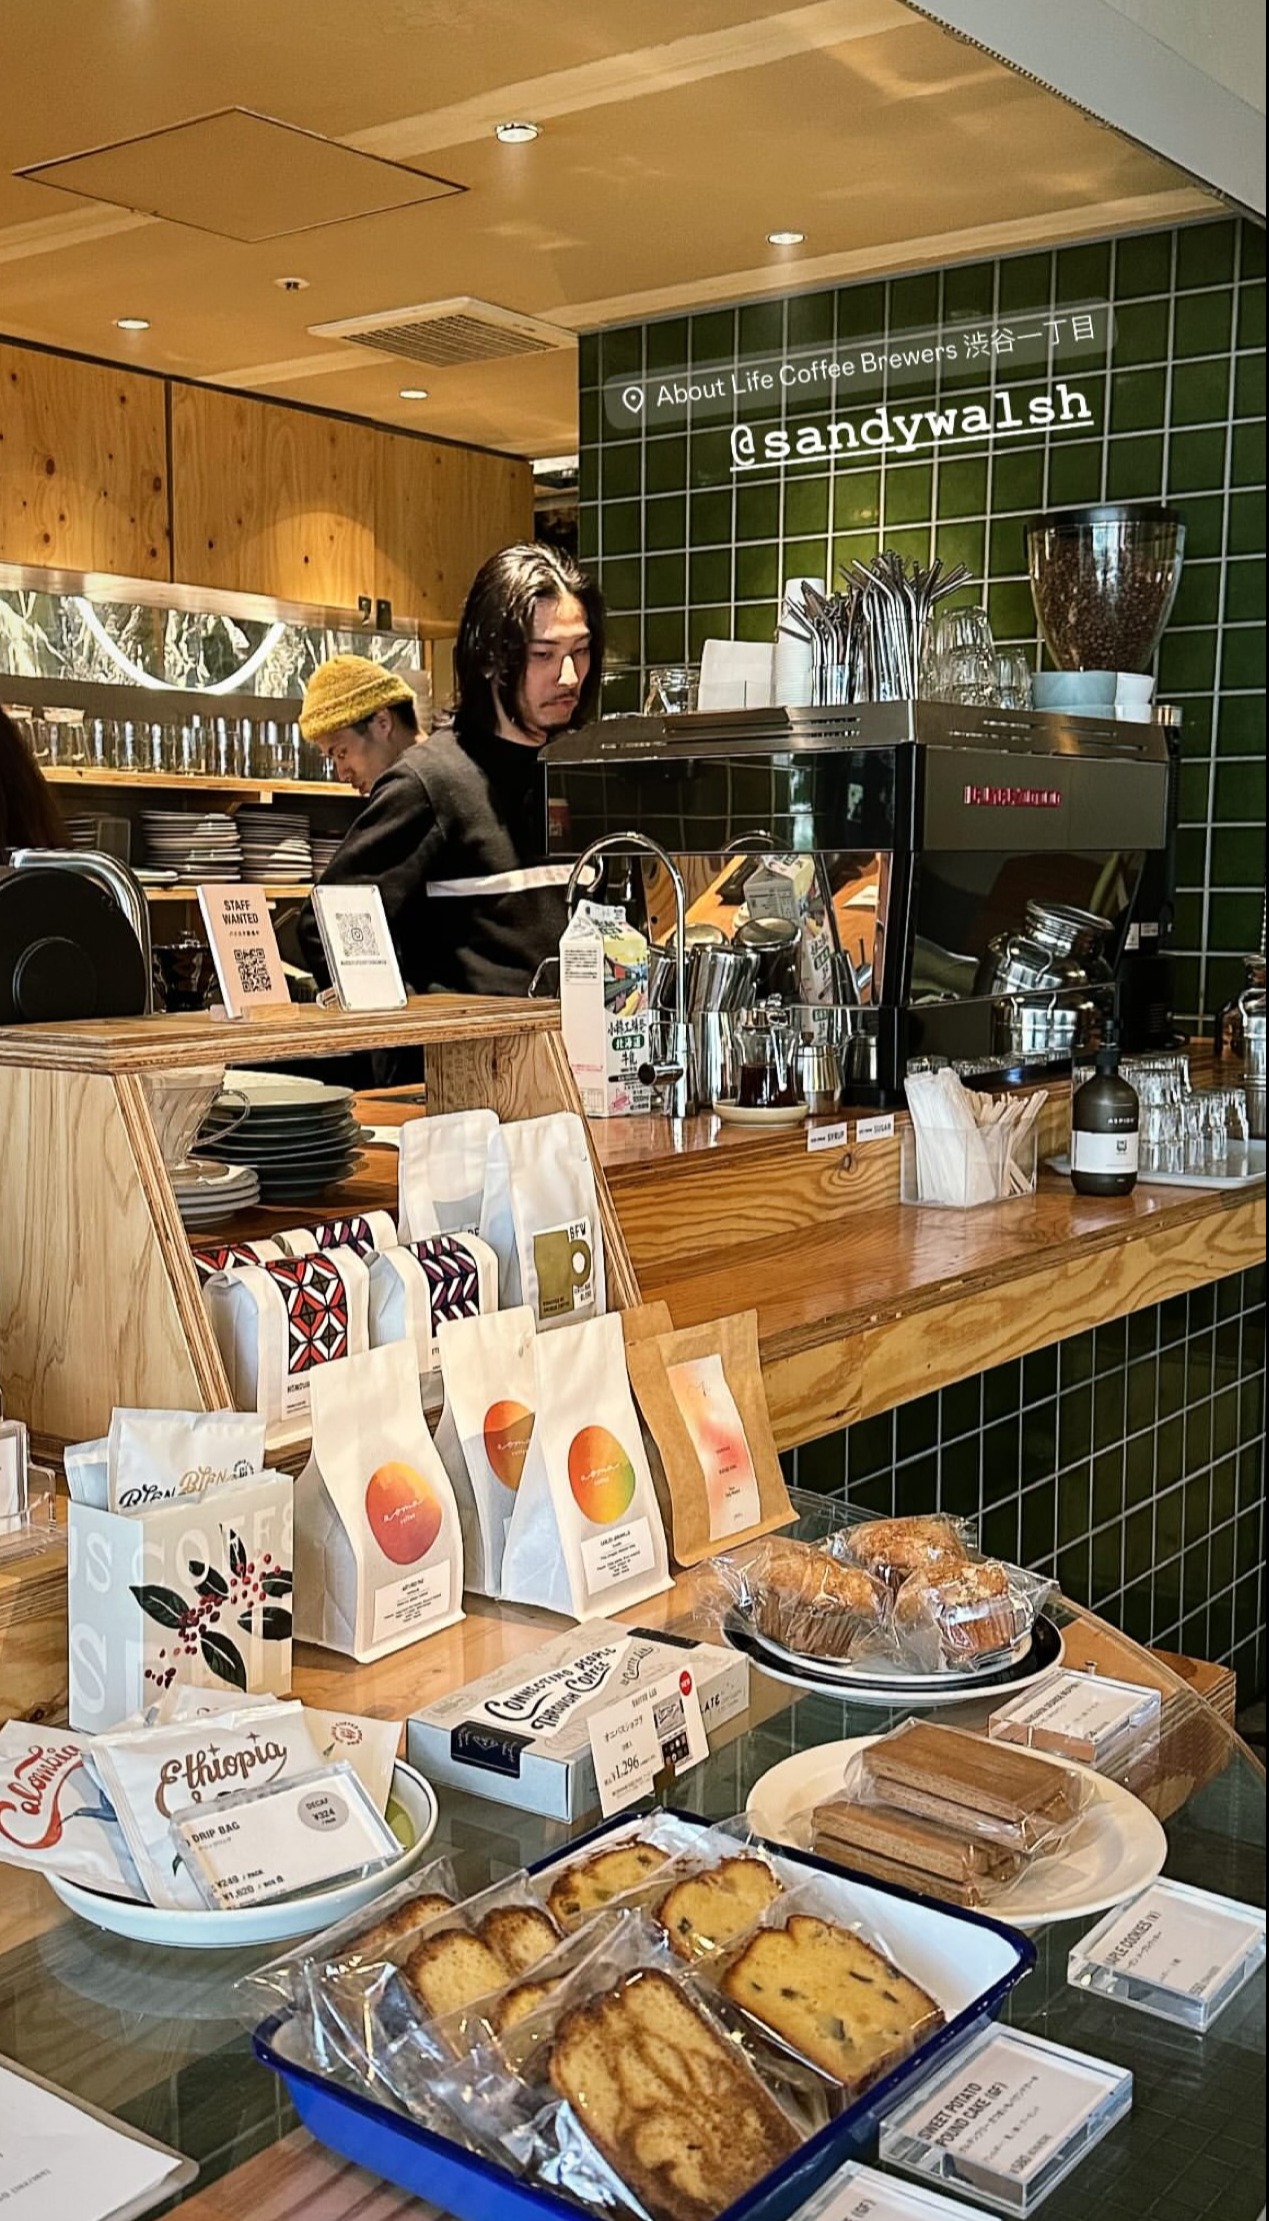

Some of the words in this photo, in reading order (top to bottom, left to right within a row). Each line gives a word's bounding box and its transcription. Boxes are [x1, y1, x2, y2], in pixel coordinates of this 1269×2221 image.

[223, 899, 251, 911] STAFF
[221, 912, 259, 925] WANTED
[616, 1035, 642, 1050] 北海道
[827, 1130, 845, 1143] SYRUP
[874, 1122, 892, 1134] SUGAR
[484, 1669, 575, 1721] CONNECTING
[574, 1646, 618, 1672] PEOPLE
[531, 1690, 582, 1730] THROUGH
[565, 1660, 612, 1693] COFFEE
[156, 1738, 288, 1803] Ethiopia
[0, 1743, 84, 1849] Colombia
[305, 1797, 329, 1810] DECAF
[312, 1808, 336, 1821] ¥324
[191, 1828, 216, 1844] DRIP
[218, 1820, 241, 1835] BAG
[1120, 1919, 1153, 1949] COOKIES
[917, 2110, 952, 2141] SWEET
[944, 2081, 982, 2114] POTATO
[935, 2117, 970, 2148] POUND
[963, 2098, 992, 2120] CAKE
[985, 2081, 1008, 2100] (GF)
[850, 2198, 878, 2218] (GF)
